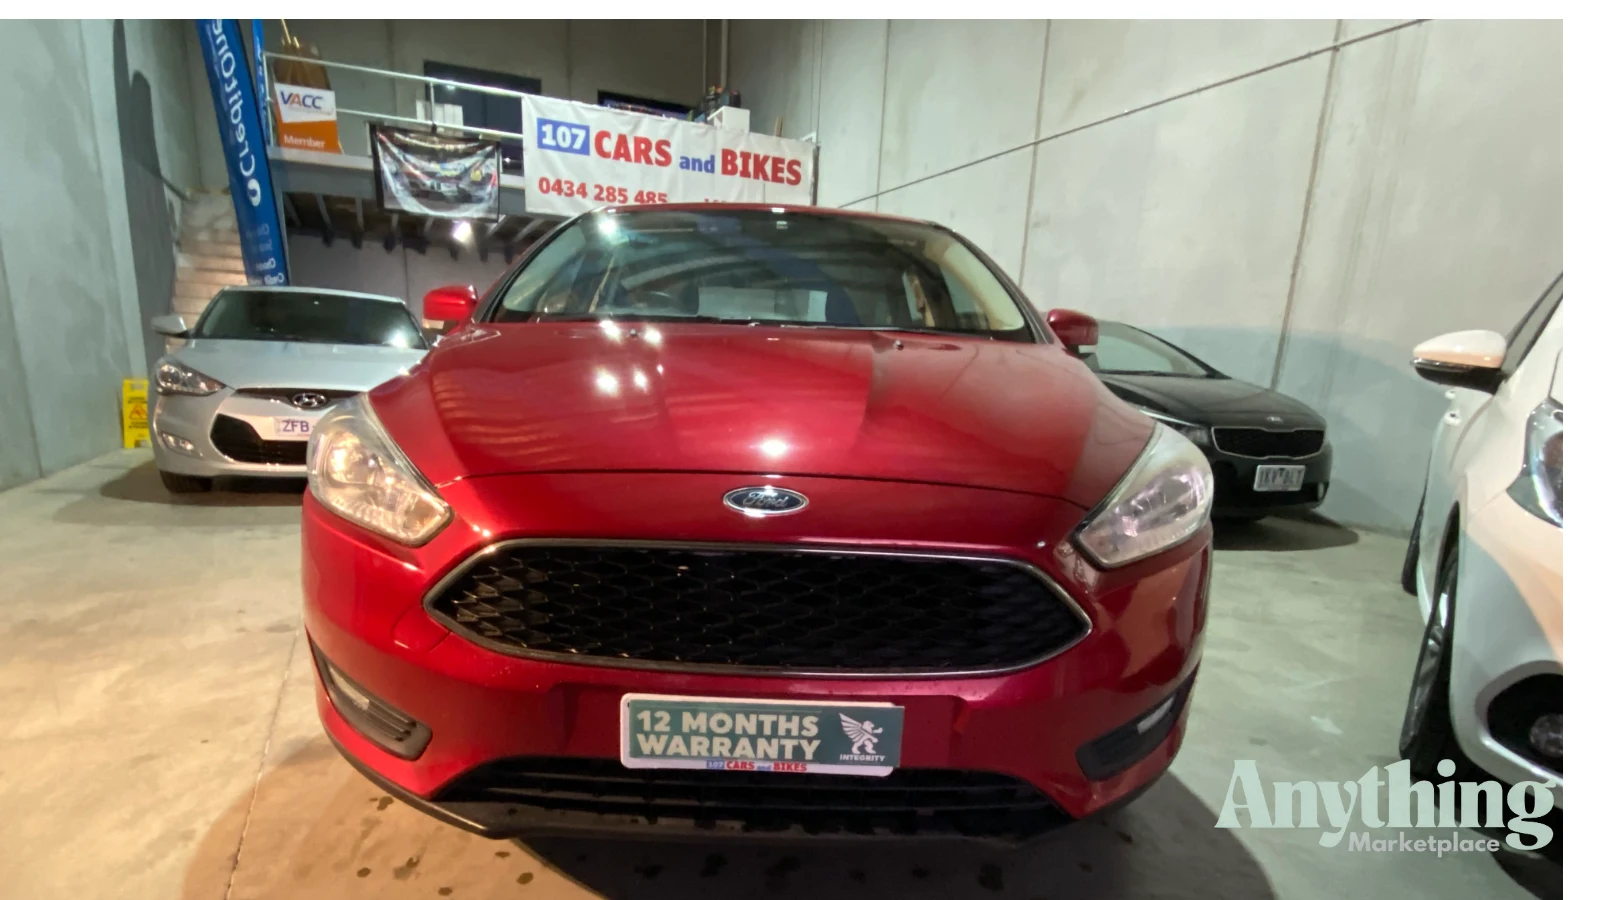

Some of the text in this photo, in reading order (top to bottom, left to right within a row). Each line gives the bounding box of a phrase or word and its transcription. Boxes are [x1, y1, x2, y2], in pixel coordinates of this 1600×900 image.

[281, 90, 324, 109] VACC
[284, 134, 326, 149] Member
[541, 123, 802, 186] 107 CARS and BIKES
[538, 177, 588, 199] 0434
[593, 184, 628, 204] 285
[282, 419, 309, 432] ZFB
[636, 710, 820, 737] 12 MONTHS
[636, 733, 822, 760] WARRANTY
[708, 761, 724, 769] 107
[726, 760, 755, 770] CARS
[773, 762, 808, 772] BIKES
[839, 753, 886, 763] INTEGRITY
